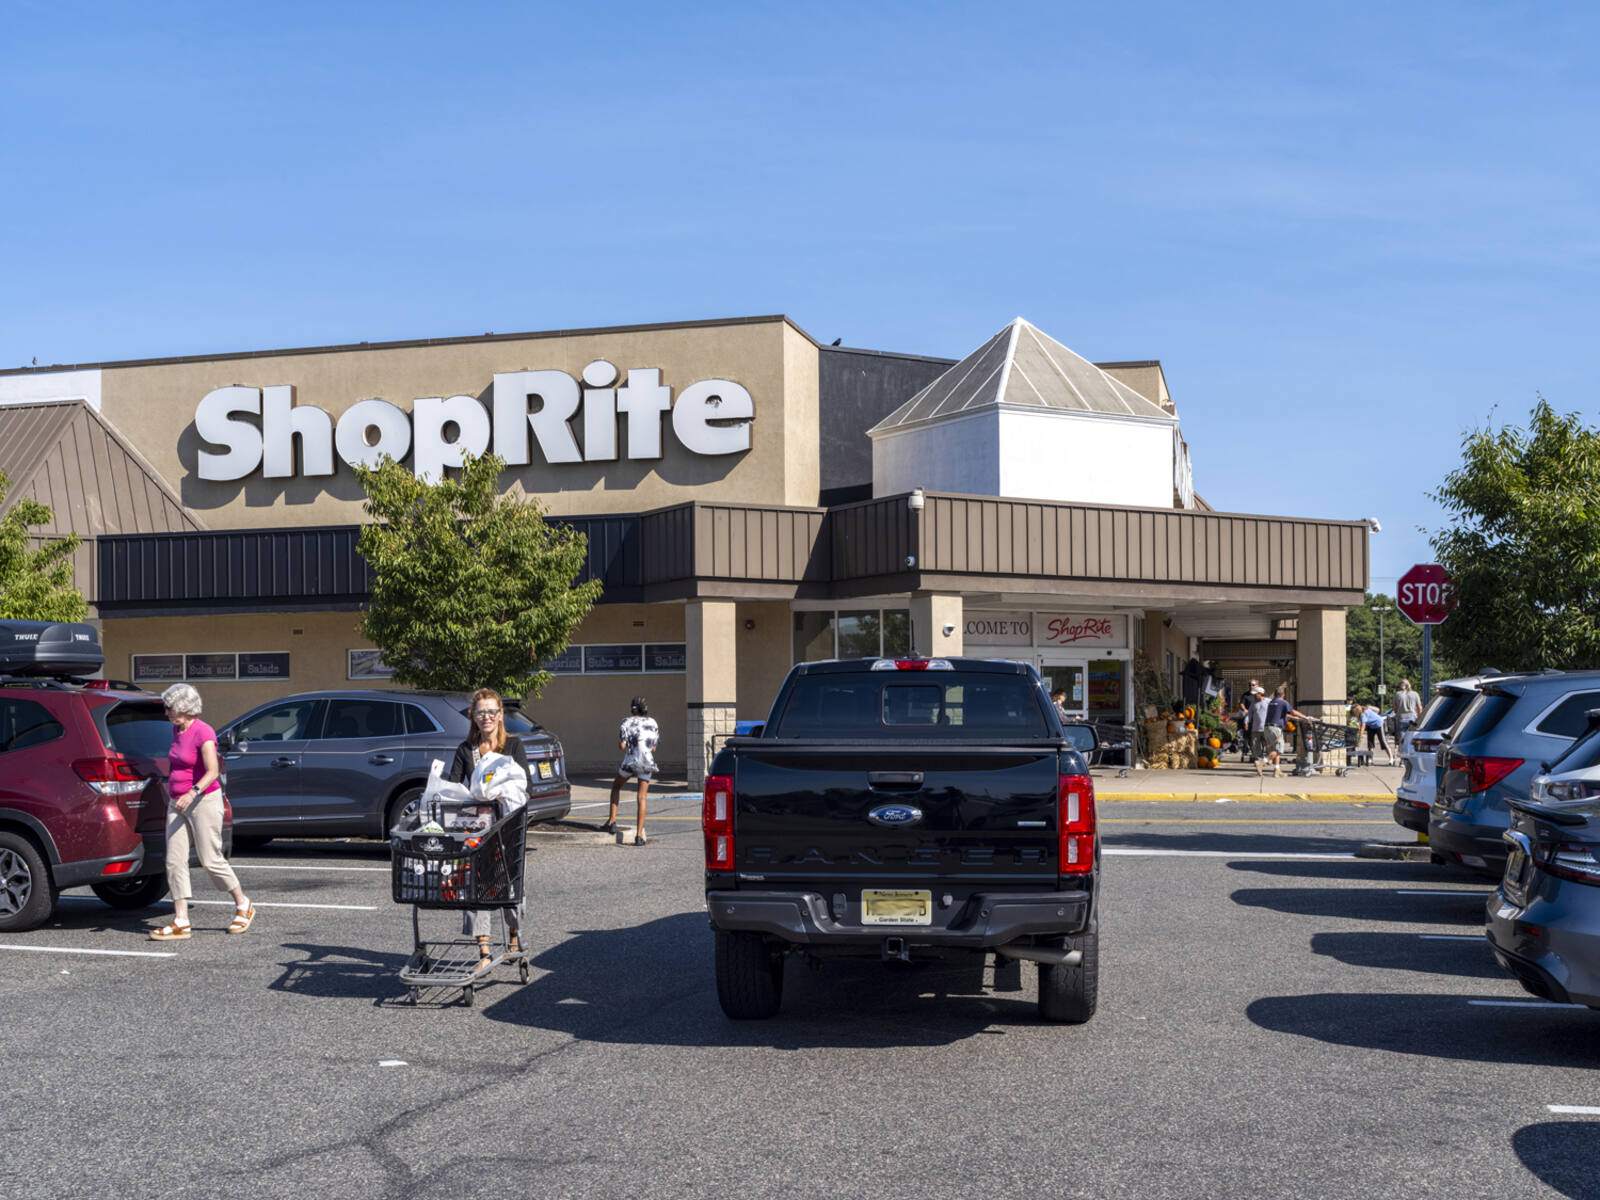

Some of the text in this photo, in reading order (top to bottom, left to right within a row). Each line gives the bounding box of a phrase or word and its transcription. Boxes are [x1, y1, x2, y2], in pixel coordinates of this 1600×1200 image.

[194, 359, 755, 486] ShopRite
[963, 620, 1029, 636] COME TO
[1046, 617, 1112, 642] ShopRite
[14, 633, 39, 641] THULE
[247, 663, 280, 674] Salads
[883, 809, 906, 820] Ford
